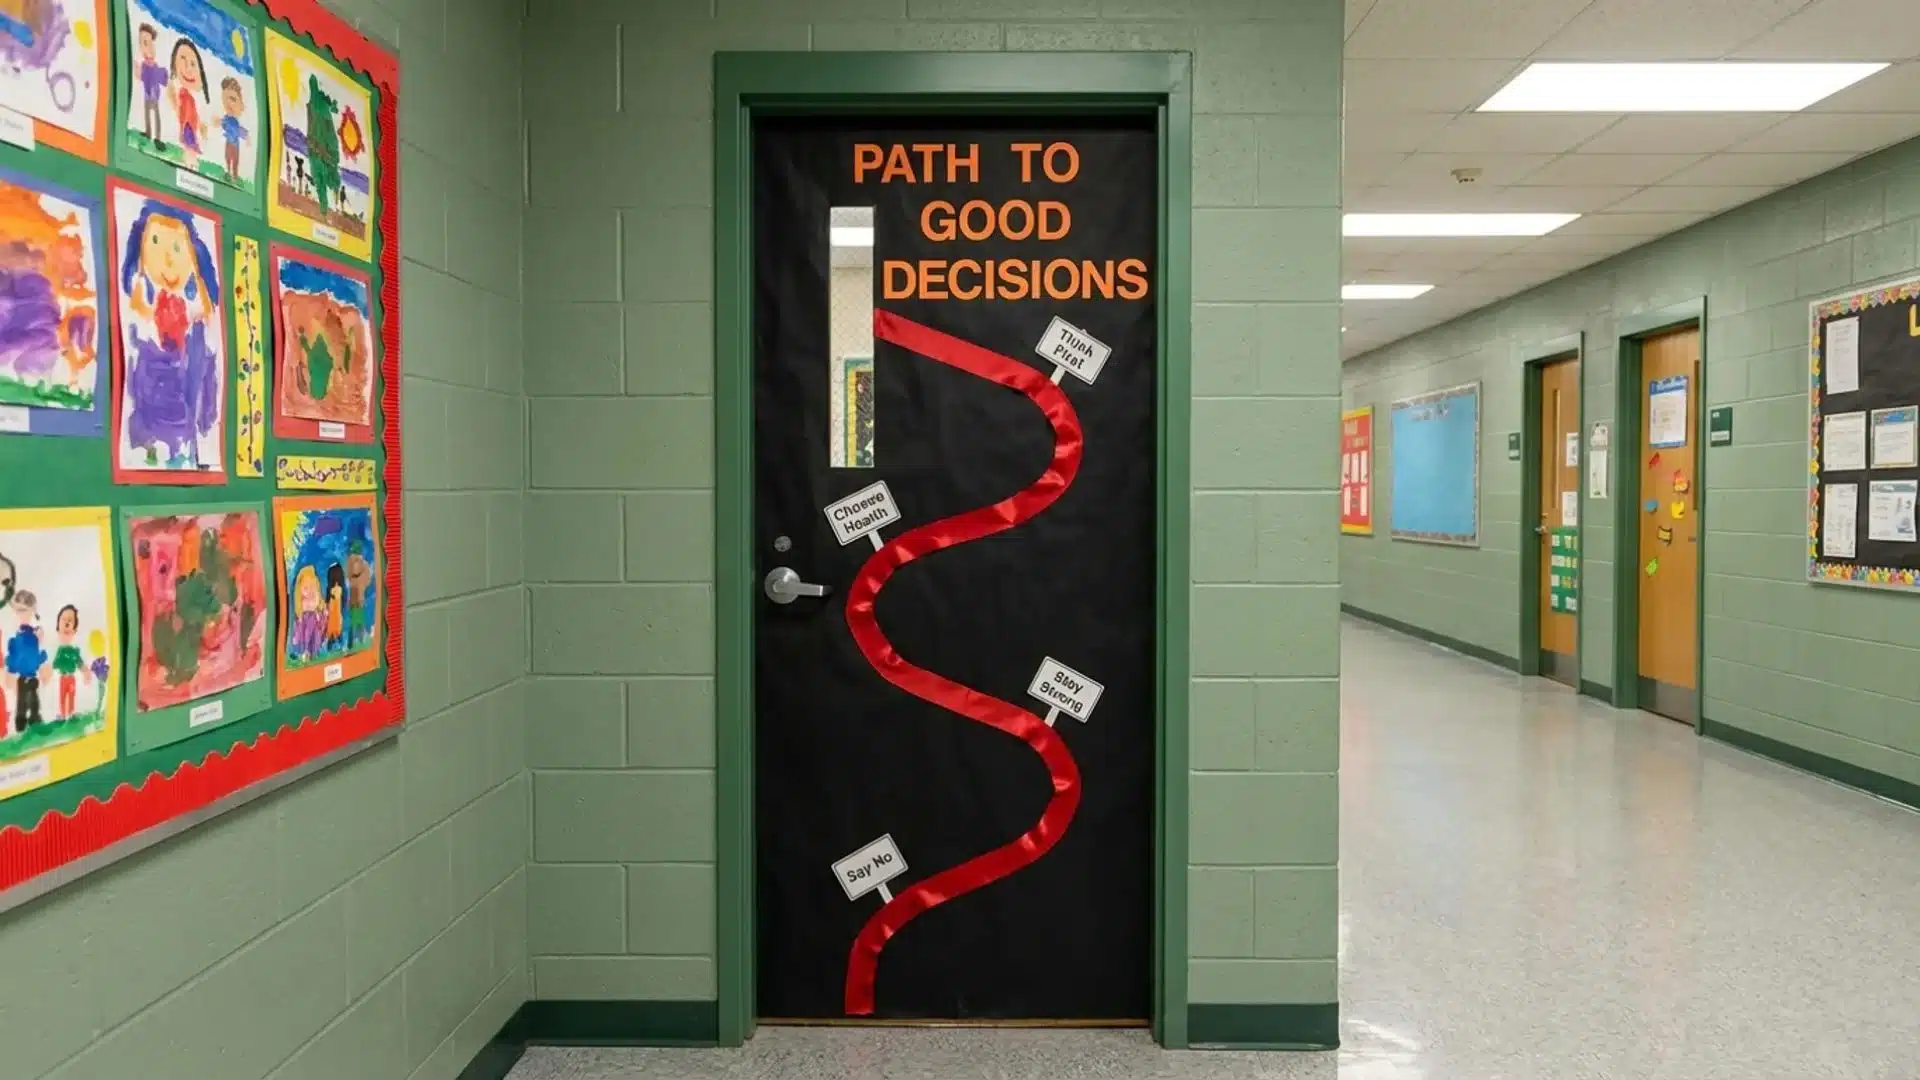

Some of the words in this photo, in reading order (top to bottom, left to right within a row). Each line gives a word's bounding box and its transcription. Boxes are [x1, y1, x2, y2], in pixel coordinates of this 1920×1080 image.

[853, 143, 980, 184] PATH
[1011, 142, 1080, 184] TO
[920, 200, 1072, 242] GOOD
[883, 258, 1149, 300] DECISIONS
[846, 863, 872, 883] Say
[872, 852, 893, 868] No
